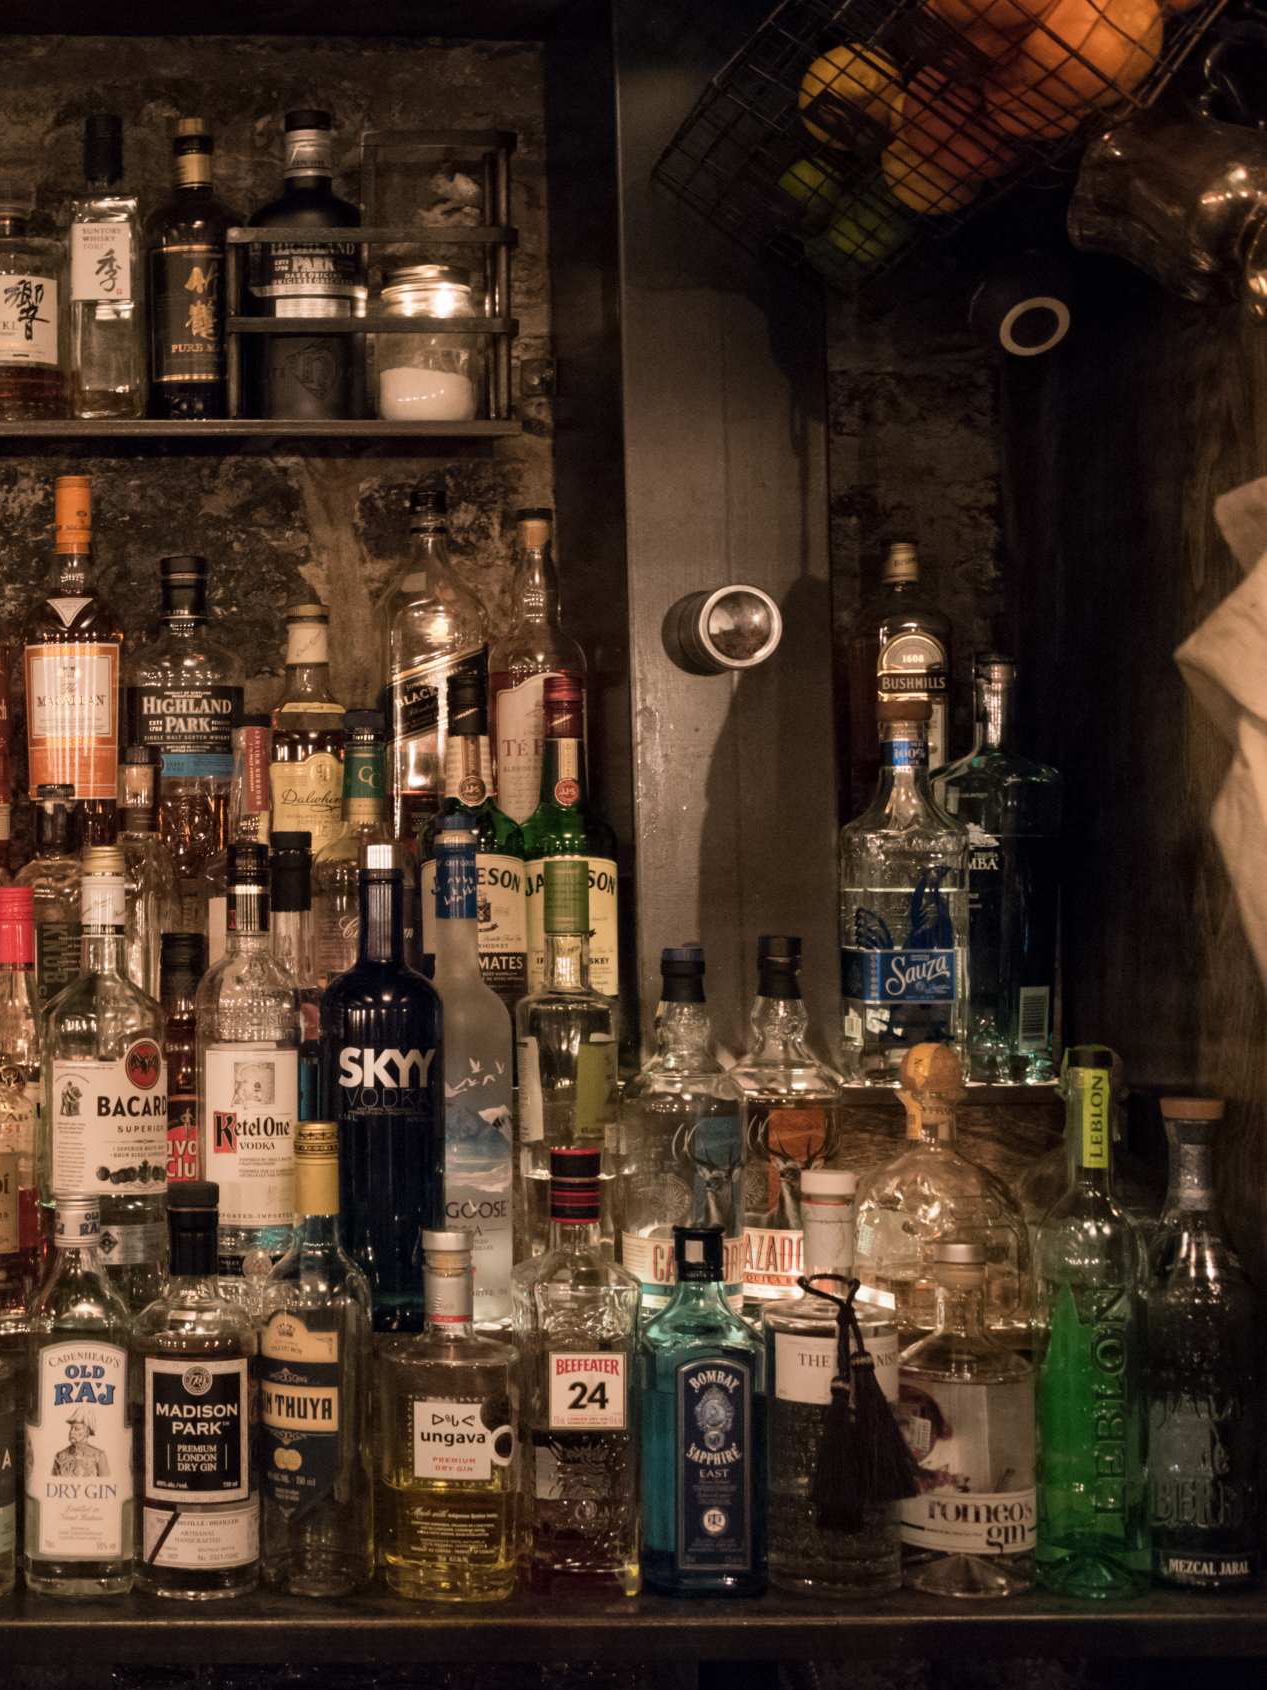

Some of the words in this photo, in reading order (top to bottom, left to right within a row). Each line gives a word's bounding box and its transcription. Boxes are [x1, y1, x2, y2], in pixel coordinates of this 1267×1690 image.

[292, 255, 335, 273] PARK
[901, 653, 925, 664] 1608
[881, 676, 947, 691] BUSHMILLS
[142, 696, 233, 715] HIGHLAND
[165, 716, 212, 733] PARK
[279, 787, 343, 806] Dalwhin
[967, 857, 1000, 871] MBA
[430, 866, 521, 896] JESON
[525, 870, 616, 897] JASON
[477, 956, 524, 970] MATES
[885, 956, 951, 996] Sauza
[337, 1046, 437, 1089] SKYY
[97, 1095, 167, 1117] BACARD
[345, 1088, 430, 1108] VODKA
[1088, 1074, 1105, 1160] LEBLON
[216, 1113, 262, 1148] Ketel
[264, 1116, 291, 1137] One
[239, 1141, 276, 1151] VODKA
[445, 1201, 508, 1220] GOOSE
[743, 1231, 804, 1273] AZADO
[745, 1274, 783, 1285] QUILA
[48, 1351, 122, 1369] CADENHEAD'S
[555, 1357, 620, 1377] BEEFEATER
[797, 1352, 832, 1368] THE
[64, 1364, 106, 1379] OLD
[688, 1370, 741, 1393] BOMBAY
[53, 1381, 116, 1406] RAJ
[567, 1381, 609, 1411] 24
[155, 1402, 238, 1418] MADISON
[274, 1394, 333, 1420] THUYA
[171, 1420, 222, 1436] PARK
[420, 1429, 487, 1448] ungava
[176, 1443, 218, 1454] PREMIUM
[176, 1453, 218, 1463] LONDON
[685, 1444, 742, 1465] SAPPHIRE
[176, 1462, 198, 1473] DRY
[200, 1462, 218, 1473] GIN
[432, 1456, 477, 1465] PREMIUM
[699, 1468, 730, 1479] EAST
[46, 1483, 81, 1499] DRY
[84, 1483, 118, 1499] GIN
[1168, 1558, 1217, 1577] MEZCAL
[1218, 1560, 1250, 1576] JARAL
